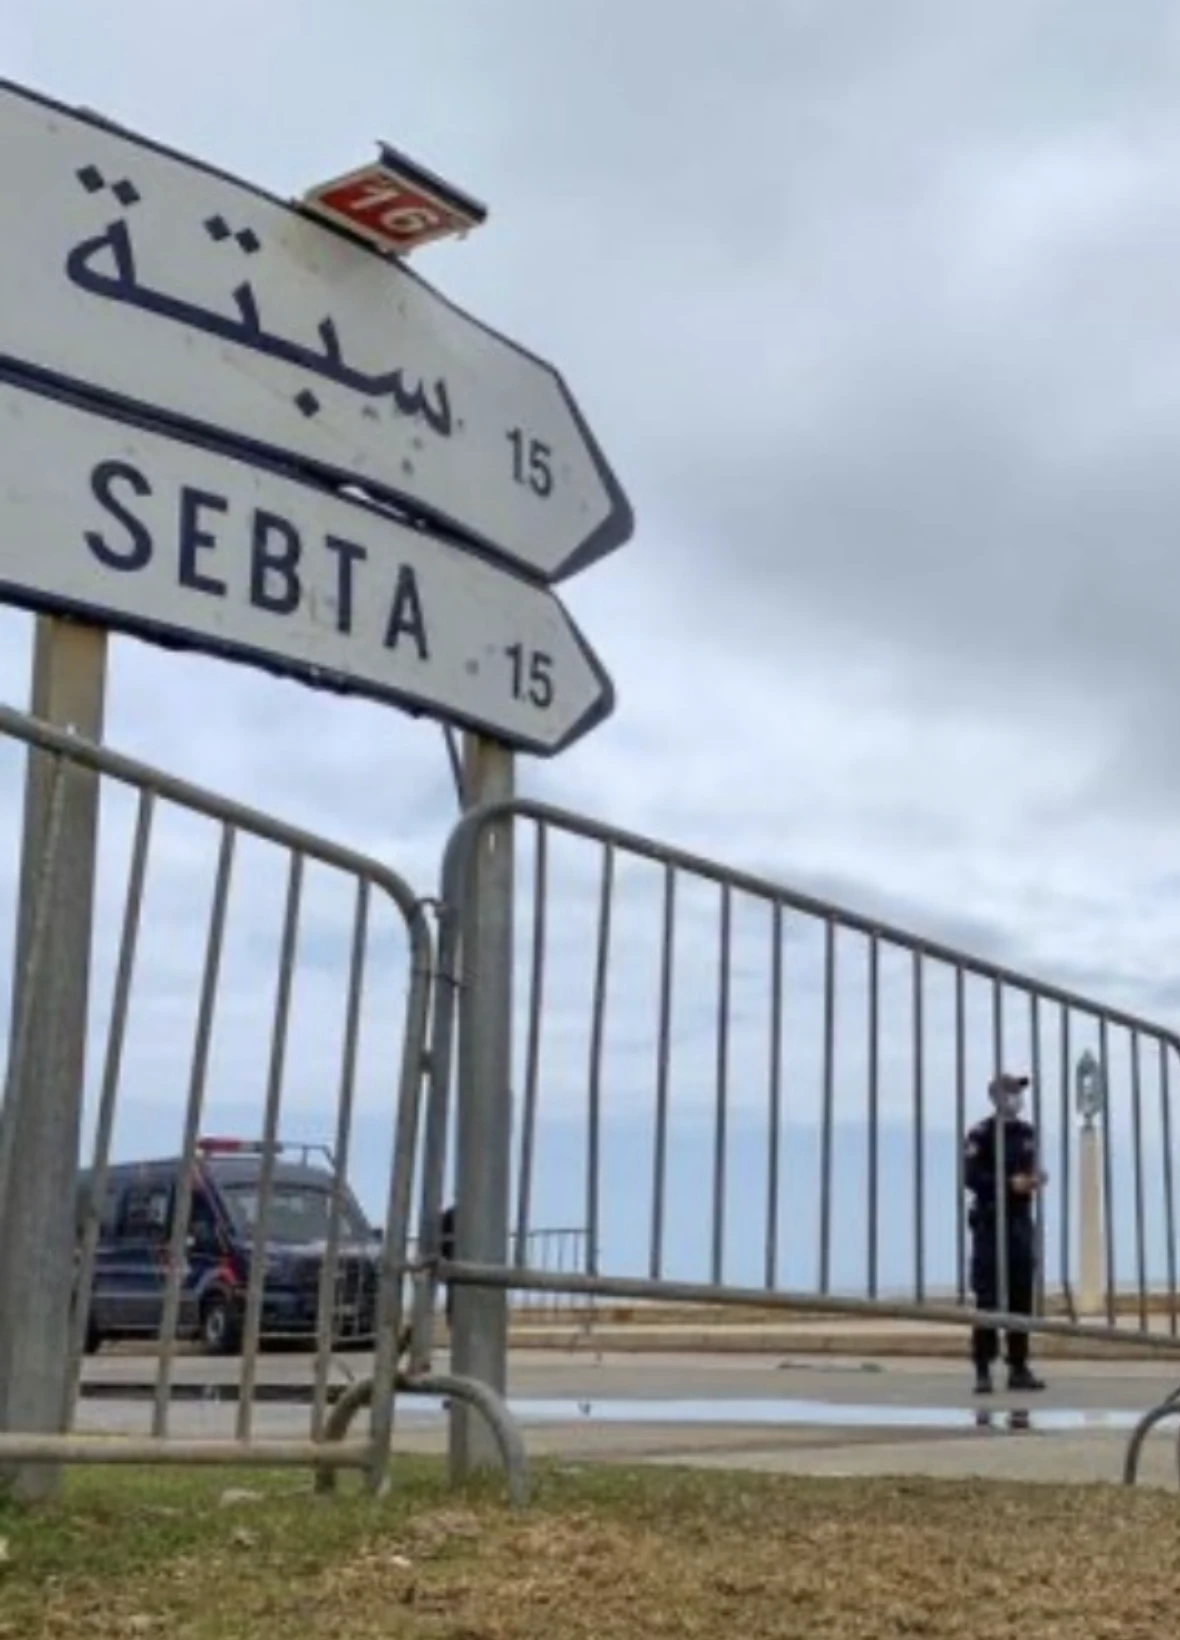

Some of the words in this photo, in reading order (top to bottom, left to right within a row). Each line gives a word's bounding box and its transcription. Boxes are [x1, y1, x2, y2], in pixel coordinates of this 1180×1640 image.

[66, 164, 453, 437] سبتة
[505, 427, 553, 498] 15
[350, 184, 440, 233] 16
[83, 459, 430, 661] SEBTA
[504, 642, 555, 709] 15
